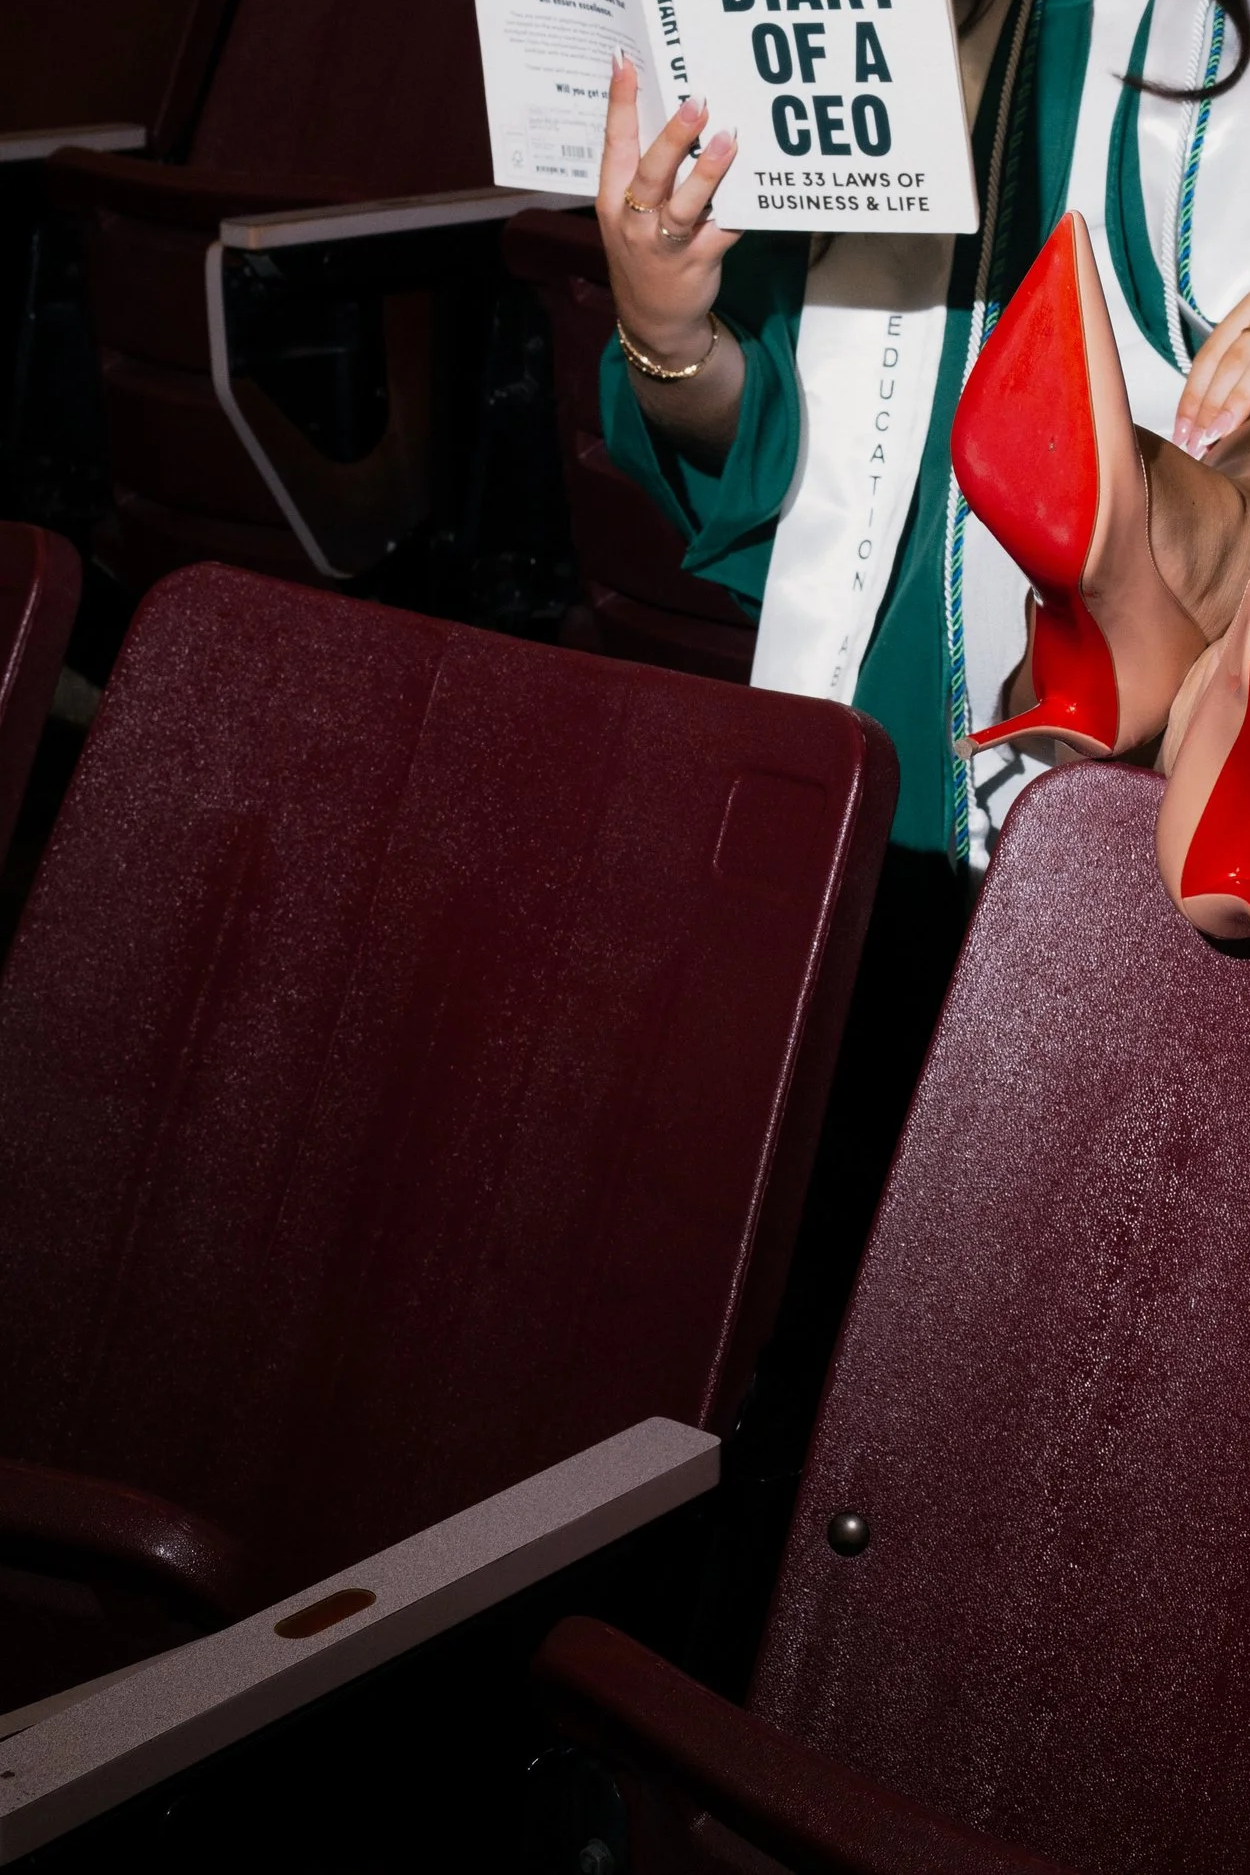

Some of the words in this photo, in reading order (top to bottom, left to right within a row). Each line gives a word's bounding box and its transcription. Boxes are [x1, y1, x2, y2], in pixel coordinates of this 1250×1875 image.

[752, 22, 827, 84] OF
[855, 21, 893, 83] A
[772, 93, 892, 157] CEO
[754, 171, 796, 187] THE
[802, 172, 826, 187] 33
[832, 172, 891, 188] LAWS
[897, 172, 925, 188] OF
[757, 194, 859, 211] BUSINESS
[866, 196, 880, 211] &
[886, 196, 930, 212] LIFE
[852, 314, 904, 591] EDUCATION
